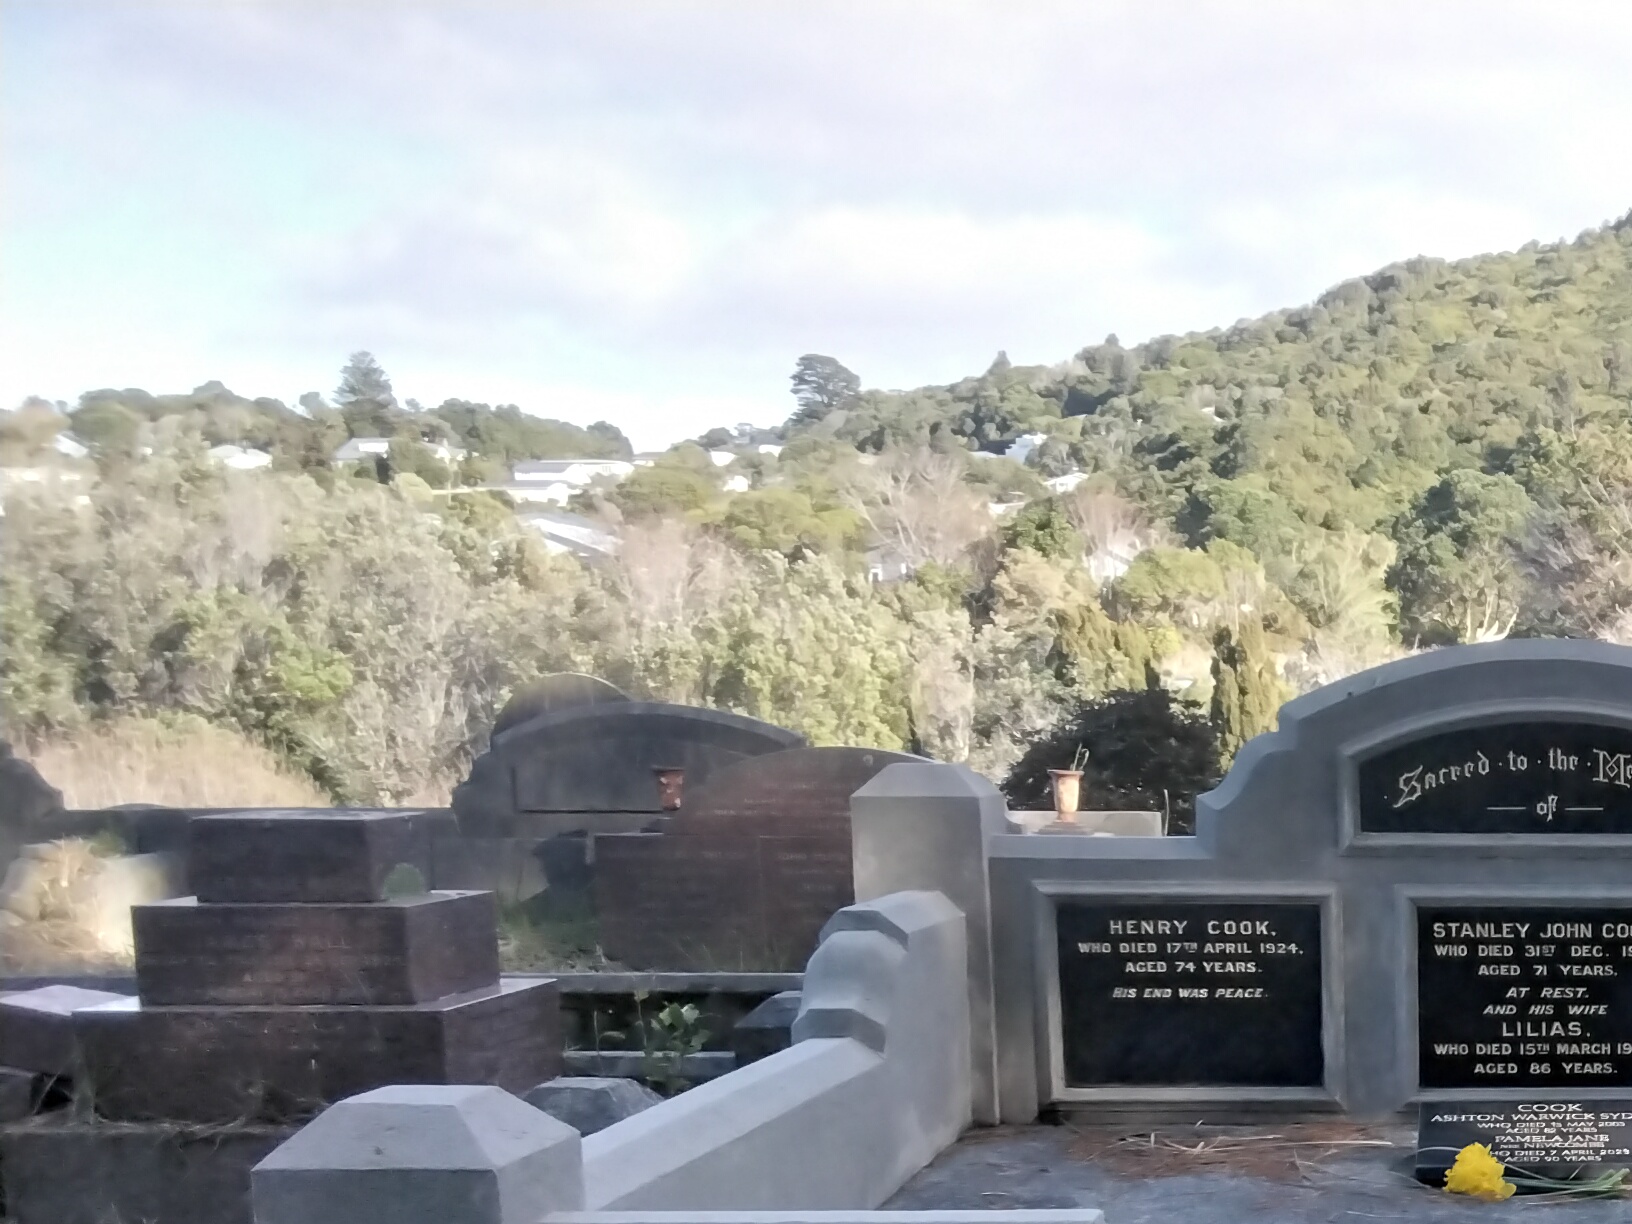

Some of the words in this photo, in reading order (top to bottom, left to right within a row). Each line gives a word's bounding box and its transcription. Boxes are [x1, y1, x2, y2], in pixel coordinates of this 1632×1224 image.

[1393, 750, 1491, 809] Sacred
[1508, 749, 1529, 772] to
[1548, 747, 1580, 773] the
[1536, 794, 1559, 822] of
[1110, 920, 1187, 934] HENRY
[1434, 923, 1530, 938] STANLEY
[1540, 923, 1592, 938] JOHN
[1078, 943, 1111, 953] WHO
[1119, 943, 1157, 953] DIED
[1204, 943, 1252, 953] APRIL
[1435, 945, 1467, 956] WHO
[1478, 945, 1513, 956] DIED
[1571, 945, 1609, 957] DEC.
[1126, 962, 1167, 972] AGED
[1175, 962, 1196, 972] 74
[1478, 965, 1520, 975] AGED
[1533, 965, 1547, 975] 71
[1113, 988, 1137, 998] HIS
[1143, 987, 1173, 998] END
[1179, 988, 1208, 998] WAS
[1505, 987, 1530, 999] AT
[1483, 1005, 1516, 1014] AND
[1529, 1005, 1554, 1015] HIS
[1569, 1005, 1608, 1014] WIFE
[1434, 1044, 1468, 1055] WHO
[1476, 1044, 1511, 1055] DIED
[1557, 1043, 1610, 1054] MARCH
[1474, 1063, 1517, 1074] AGED
[1530, 1063, 1551, 1074] 86
[1518, 1104, 1582, 1112] COOK
[1430, 1114, 1505, 1122] ASHTON
[1511, 1112, 1596, 1120] WARWICK
[1494, 1135, 1565, 1143] PAMELA
[1566, 1134, 1610, 1142] JANE
